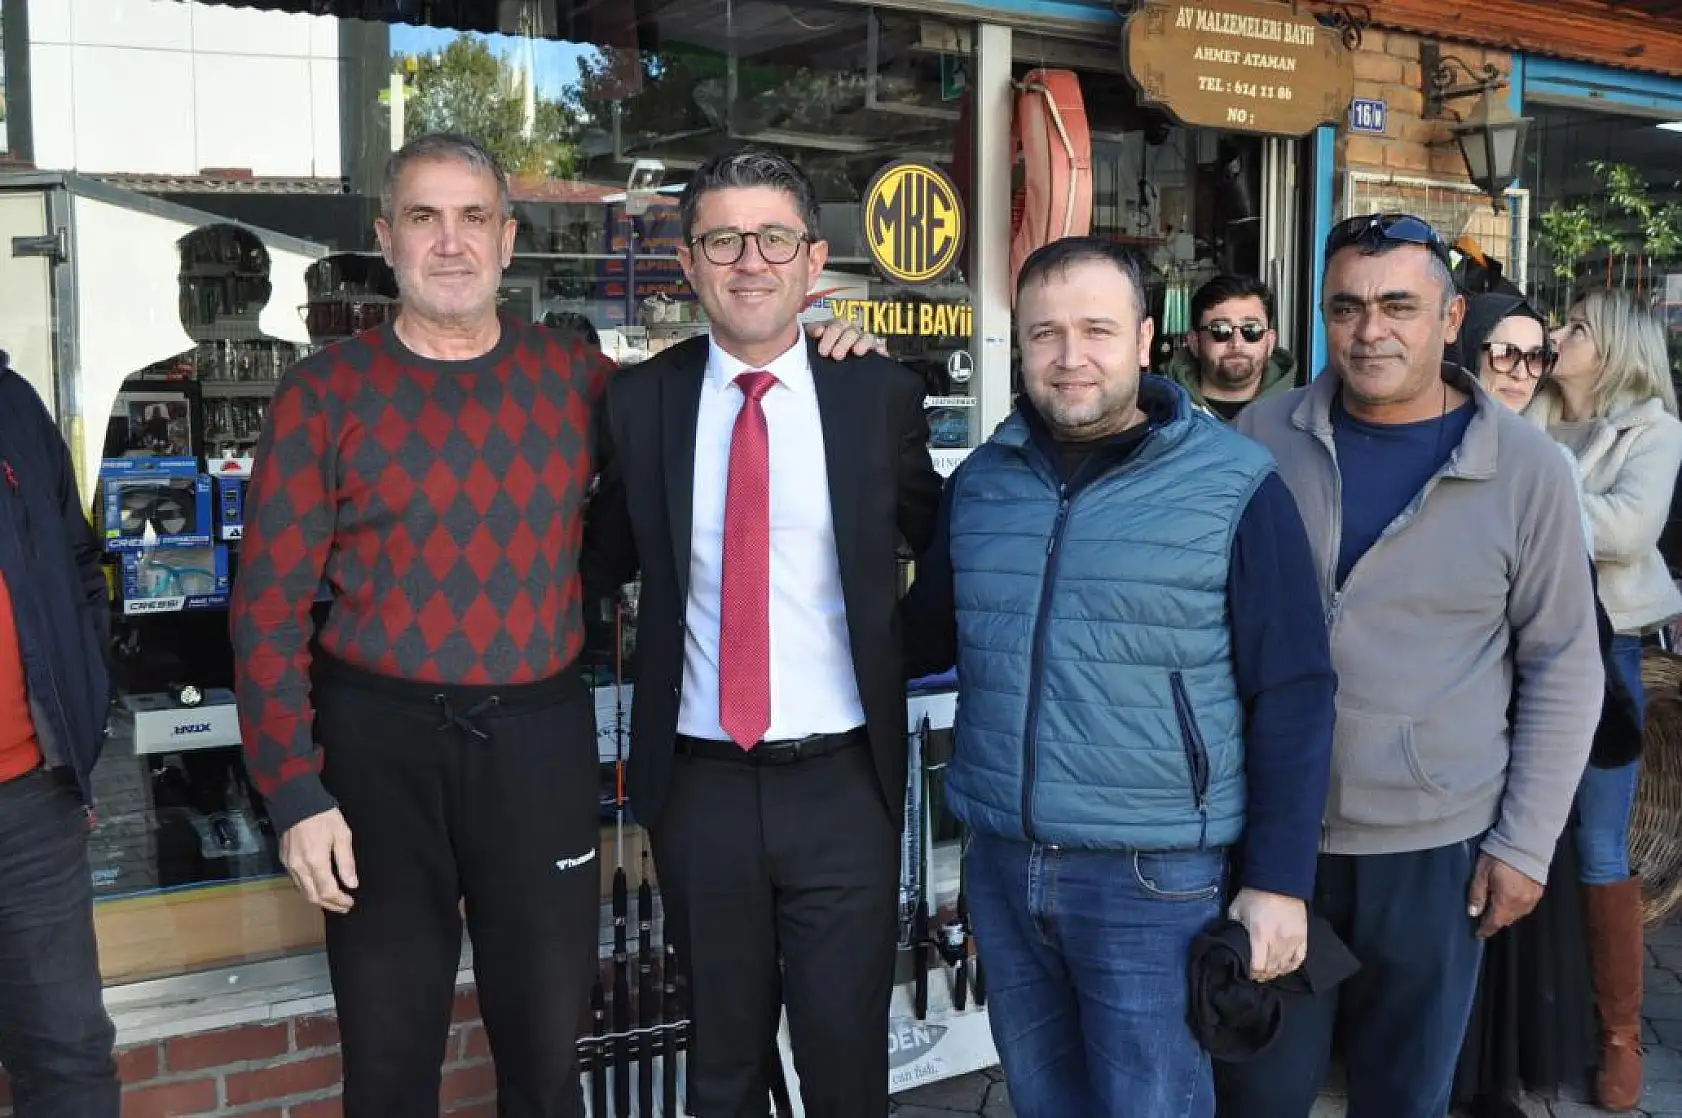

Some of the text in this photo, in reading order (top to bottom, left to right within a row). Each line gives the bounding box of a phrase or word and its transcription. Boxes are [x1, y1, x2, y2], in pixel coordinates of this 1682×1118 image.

[1175, 5, 1194, 29] AV
[1193, 46, 1297, 71] AHMET ATAMAN
[873, 171, 954, 273] MKE
